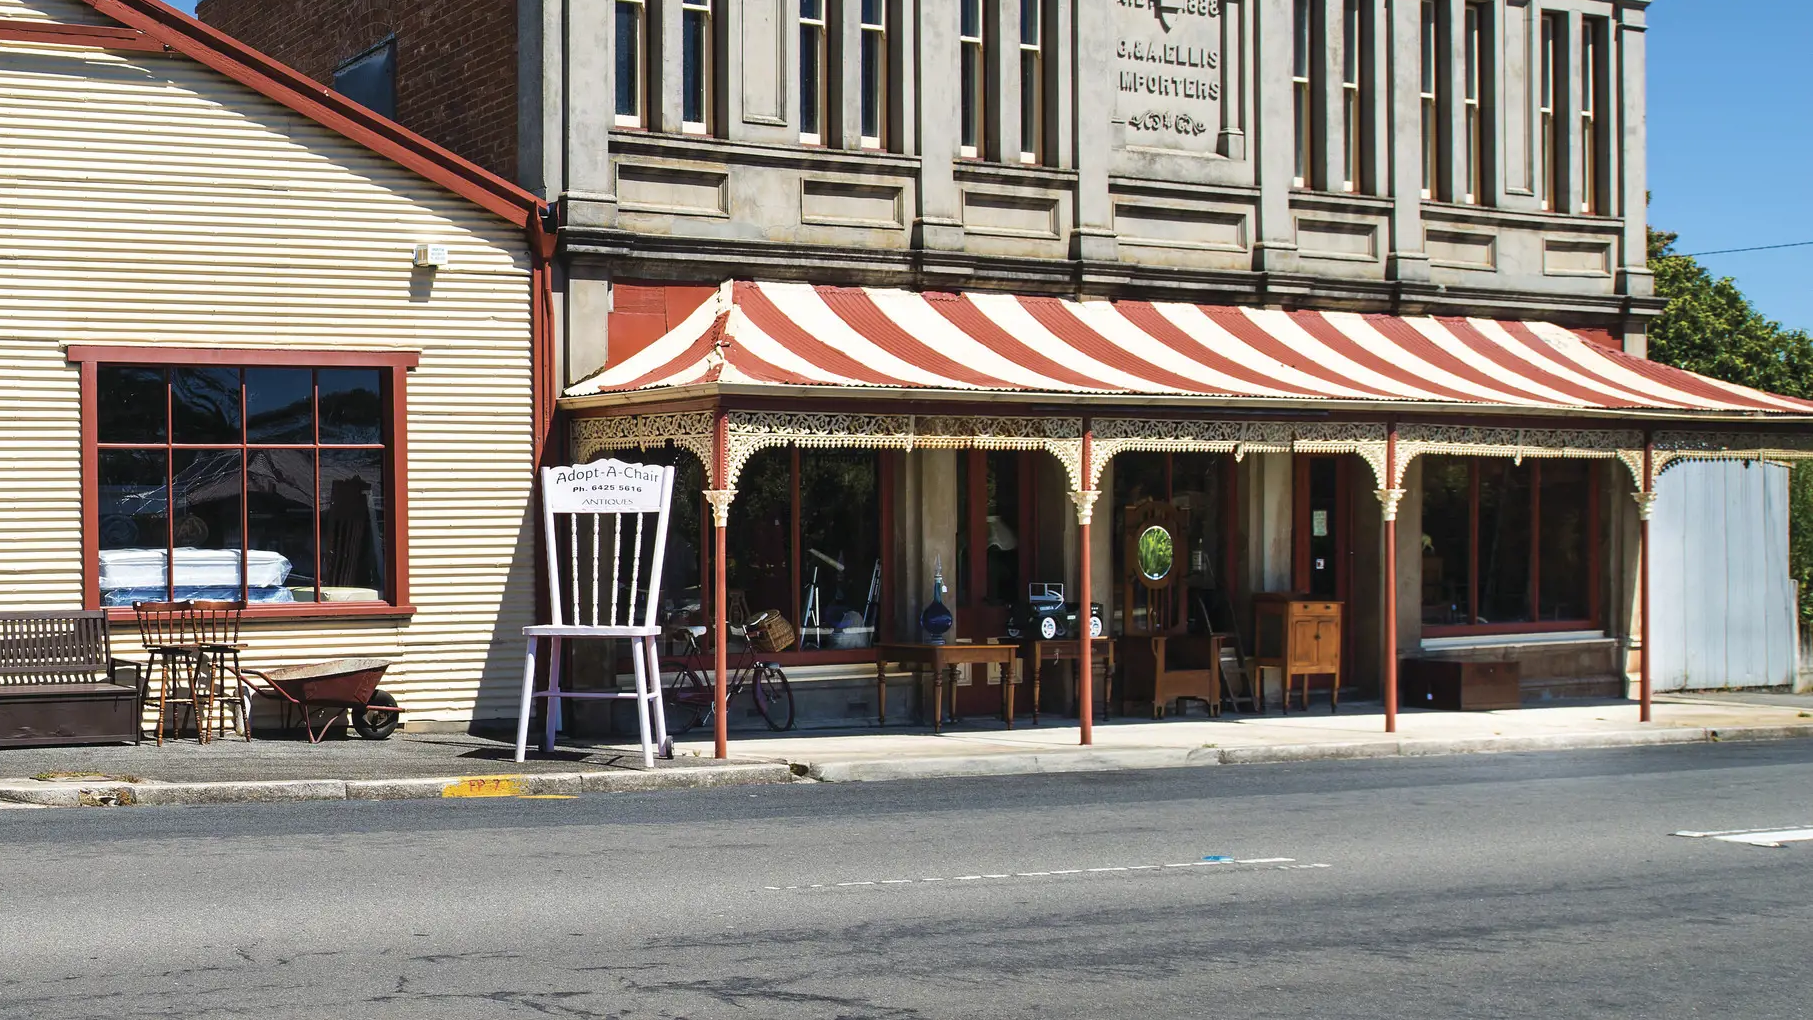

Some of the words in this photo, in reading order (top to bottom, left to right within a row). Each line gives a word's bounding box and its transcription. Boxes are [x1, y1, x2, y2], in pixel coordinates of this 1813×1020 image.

[1118, 70, 1219, 101] MPORTERS
[556, 466, 659, 484] Adopt-A-Chair
[572, 485, 588, 493] Ph.
[618, 485, 642, 493] 5616
[582, 498, 633, 506] ANTIQUES
